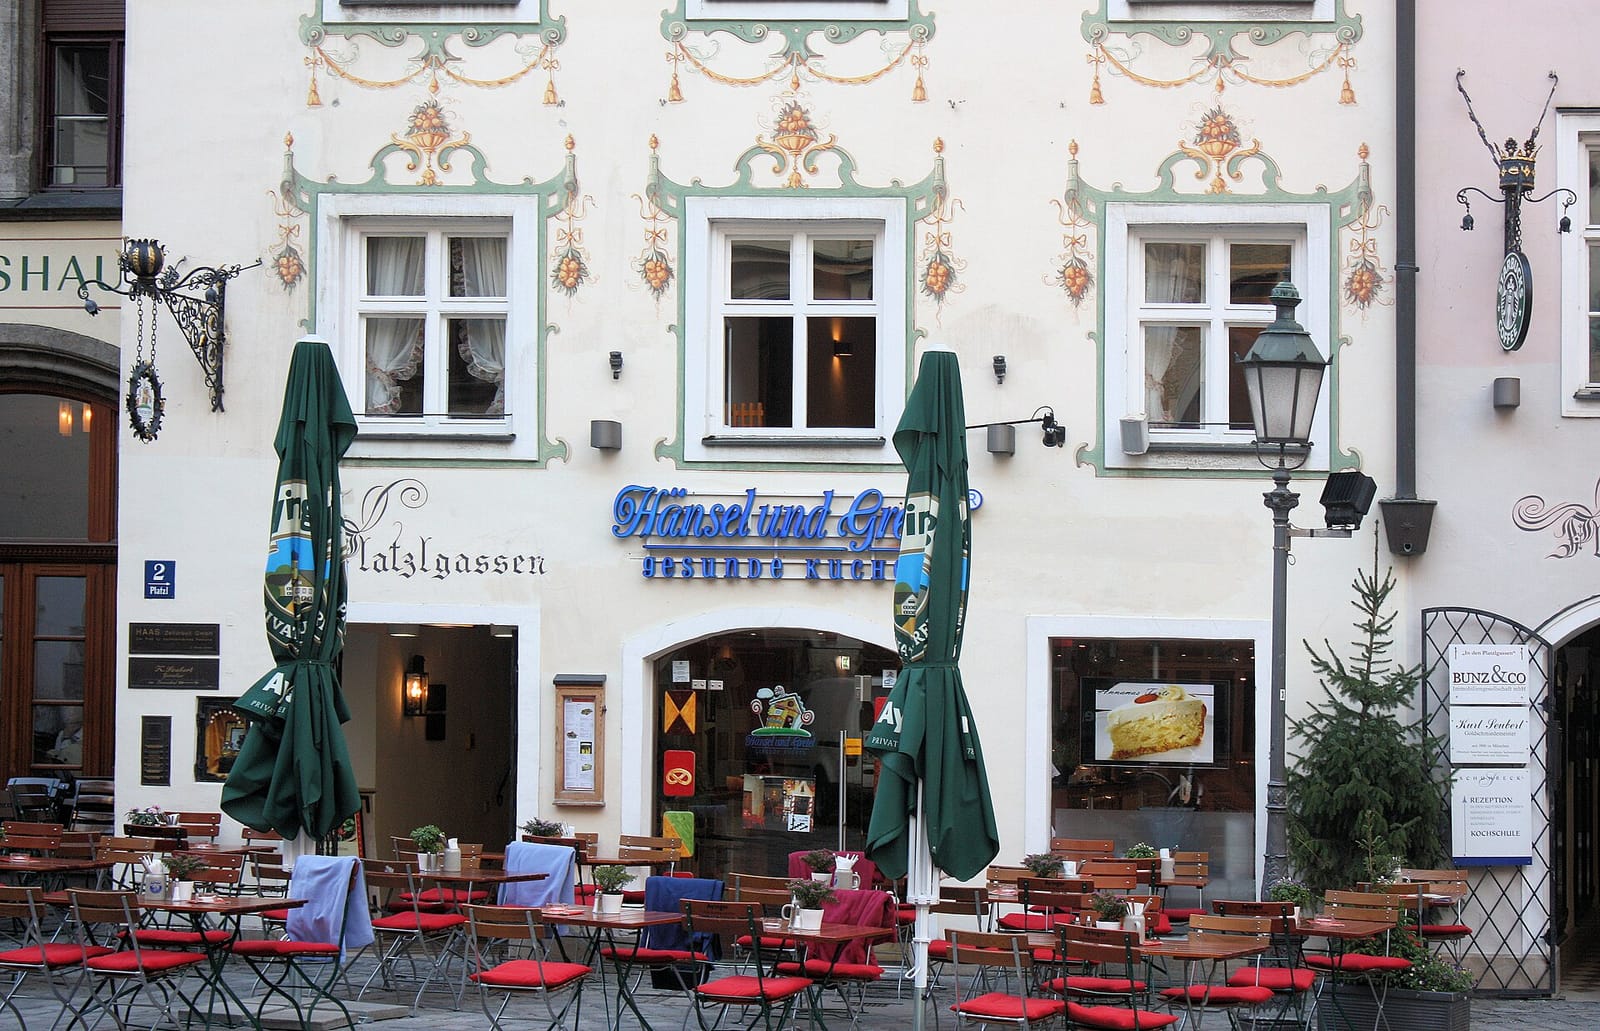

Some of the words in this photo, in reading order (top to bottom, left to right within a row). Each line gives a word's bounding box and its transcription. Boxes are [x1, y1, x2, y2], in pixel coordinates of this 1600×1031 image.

[612, 485, 756, 538] Hänsel
[758, 488, 835, 539] und
[153, 563, 165, 581] 2
[1453, 664, 1527, 684] BUNZ&CO
[1456, 719, 1483, 729] Kurt
[1485, 719, 1524, 729] Seubert
[1470, 796, 1513, 804] REZEPTION
